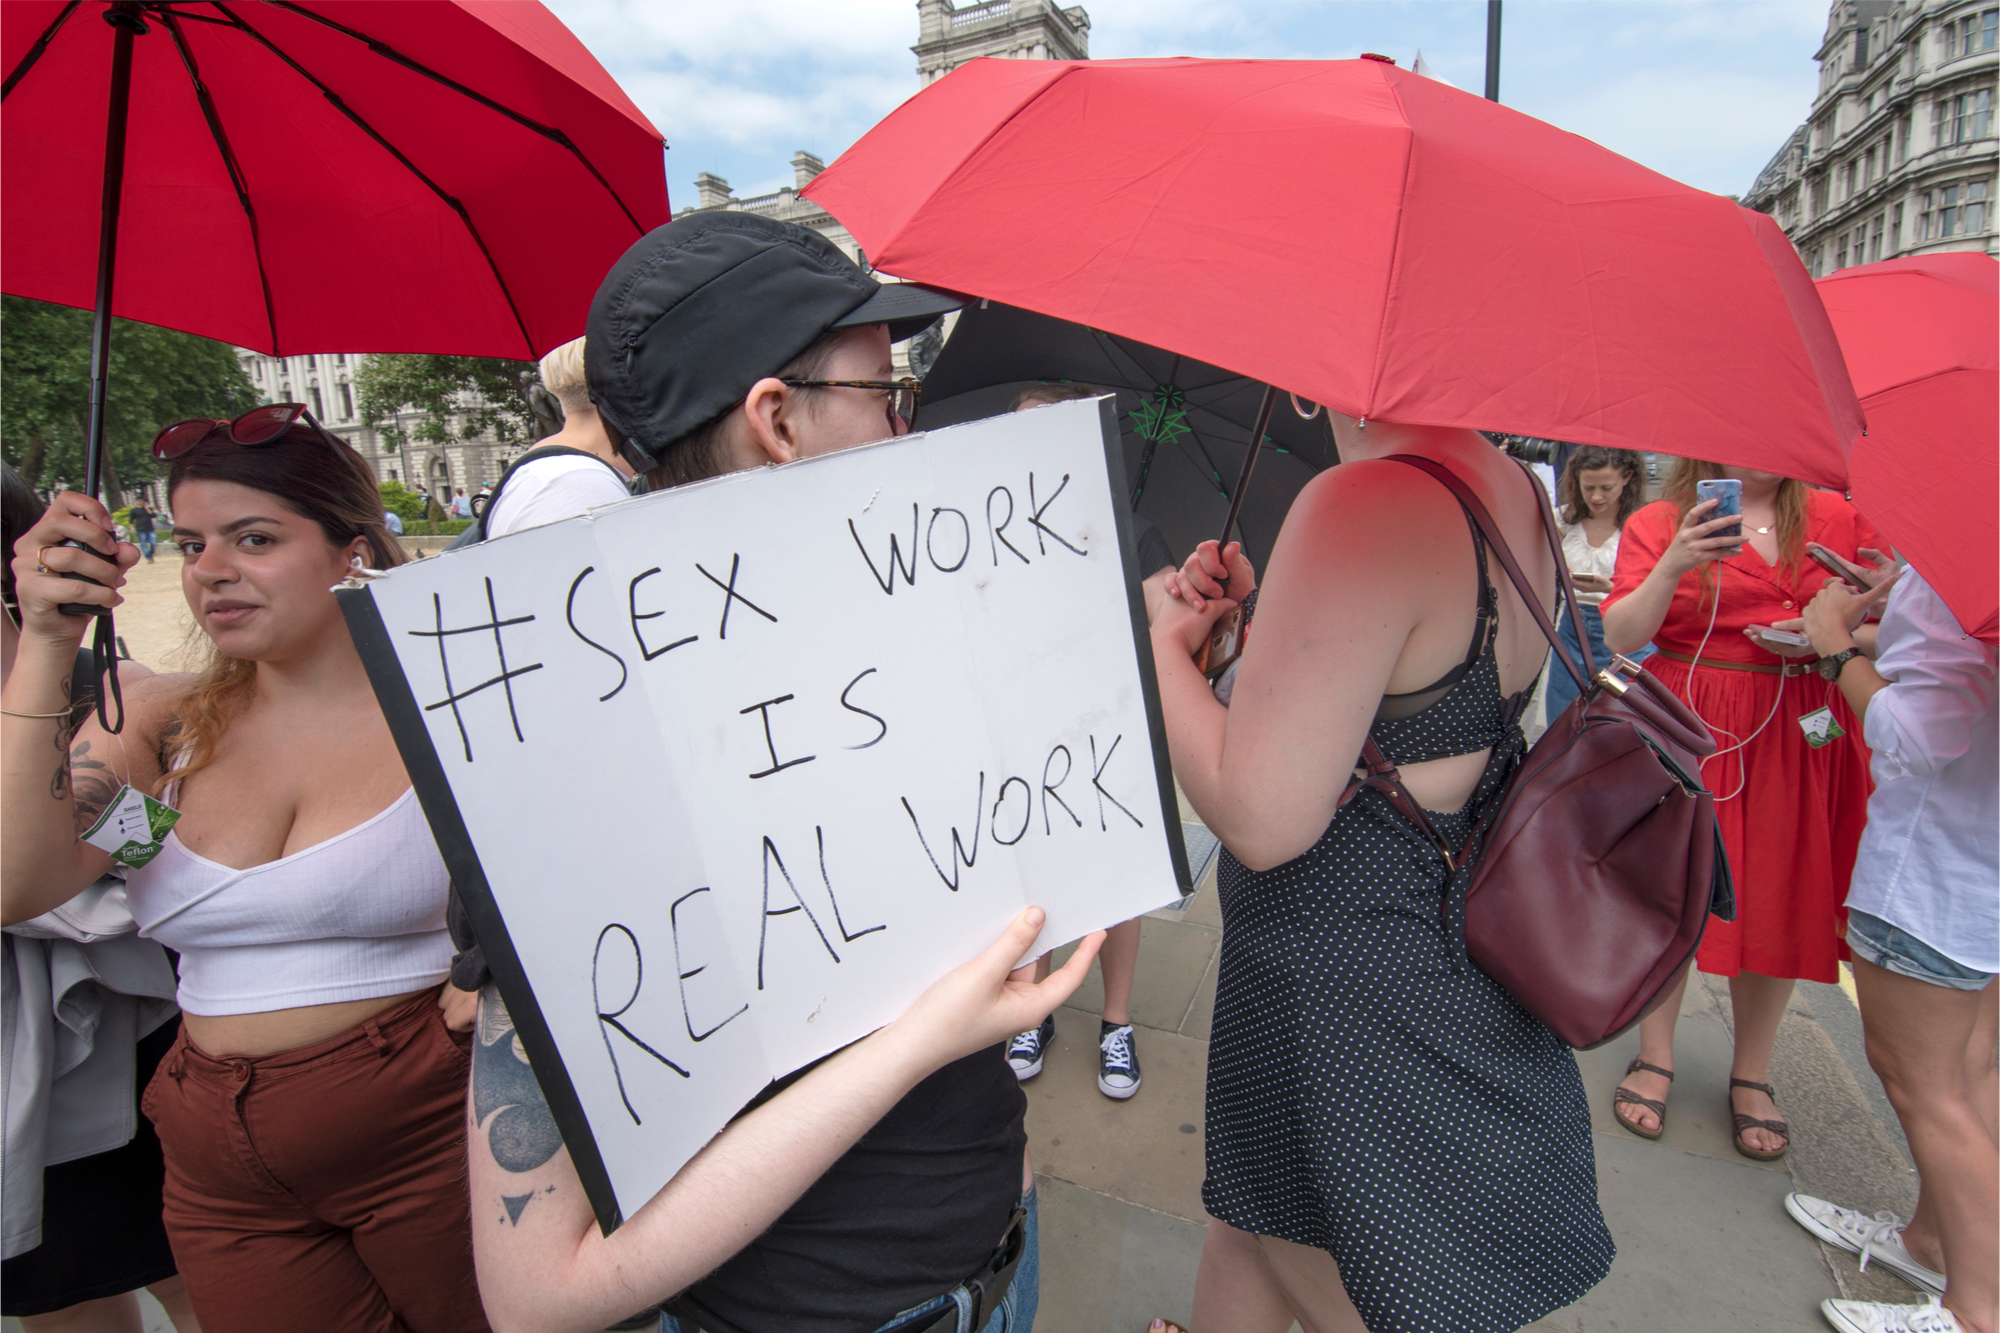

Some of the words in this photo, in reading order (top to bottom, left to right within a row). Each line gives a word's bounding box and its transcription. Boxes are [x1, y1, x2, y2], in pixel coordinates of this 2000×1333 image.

[408, 553, 777, 762] #SEX
[849, 474, 1087, 594] WORK
[740, 668, 887, 778] IS
[121, 846, 154, 857] Teflon
[123, 804, 143, 812] SHIELD
[592, 826, 886, 1125] REAL
[901, 735, 1143, 892] WORK
